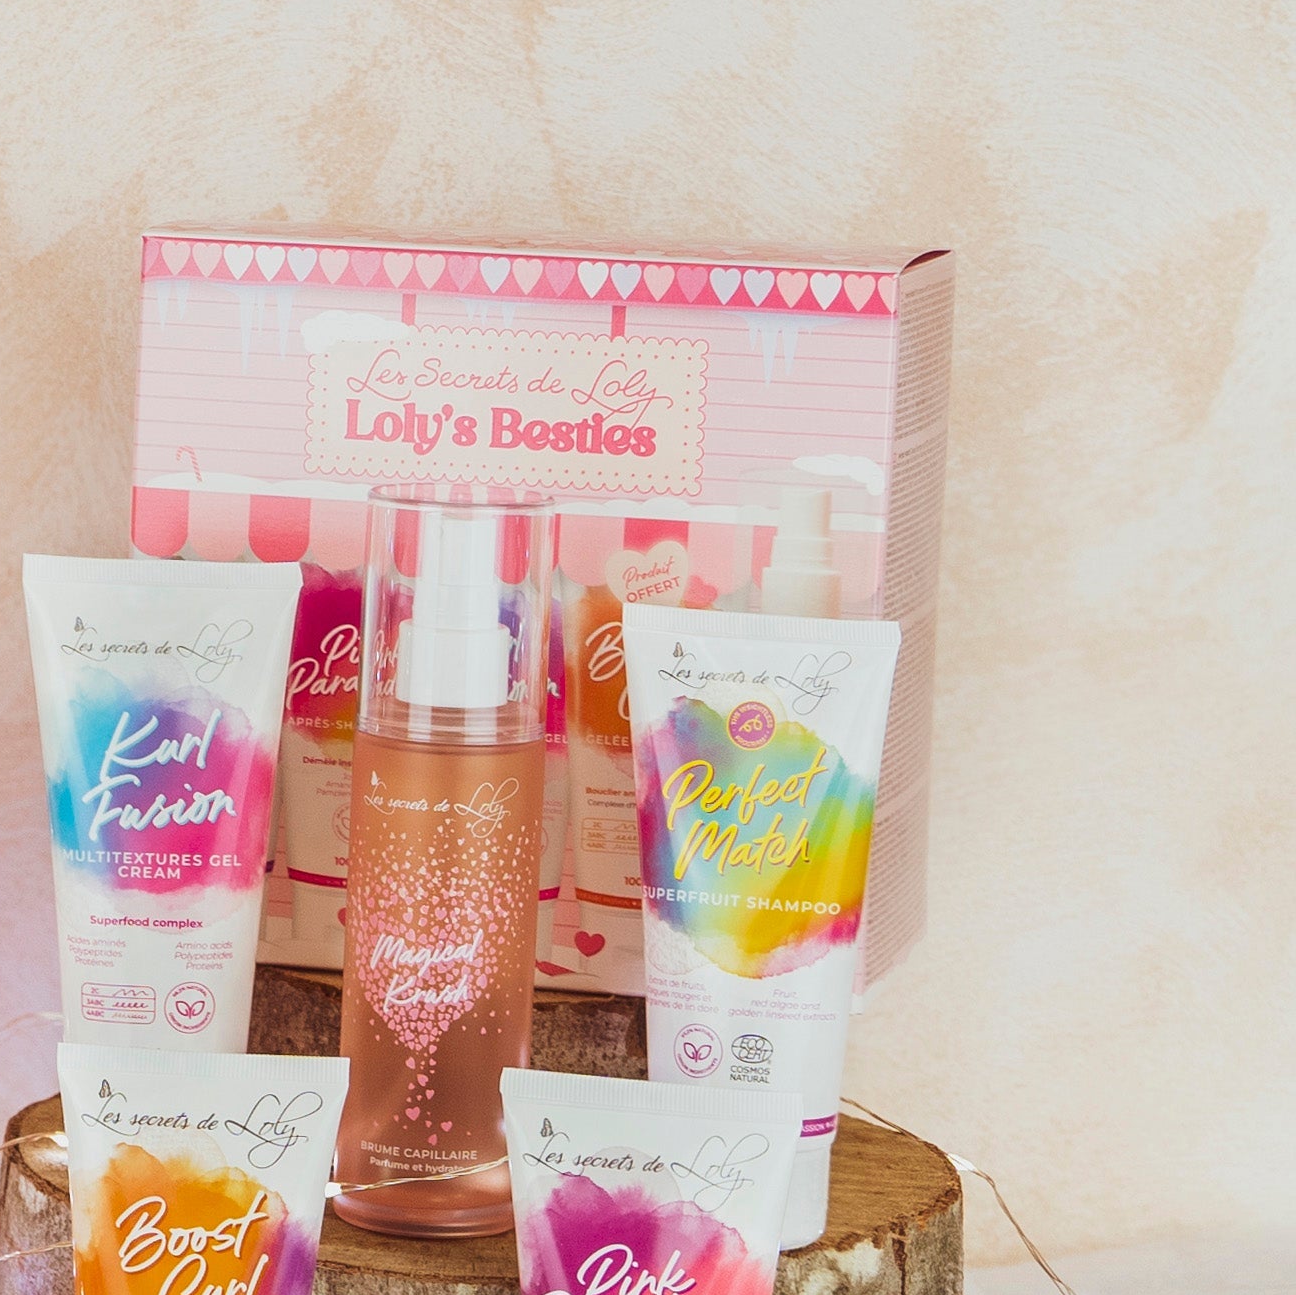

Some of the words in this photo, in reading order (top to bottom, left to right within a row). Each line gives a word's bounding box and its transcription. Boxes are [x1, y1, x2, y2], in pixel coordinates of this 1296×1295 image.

[347, 349, 411, 401] Les
[414, 358, 518, 393] Secrets
[527, 366, 565, 393] de
[571, 359, 674, 432] Loly
[344, 398, 478, 455] Loly's
[489, 407, 657, 457] Besties
[623, 556, 674, 589] Produit
[627, 576, 680, 603] OFFERT
[61, 626, 109, 662] Les
[100, 641, 147, 654] secrets
[155, 641, 172, 655] de
[176, 619, 253, 683] Loly
[659, 653, 708, 689] Les
[699, 670, 746, 684] secrets
[752, 671, 769, 685] de
[775, 651, 852, 715] Loly
[100, 708, 223, 782] Kurl
[587, 735, 629, 746] GELÉE
[82, 774, 237, 841] Fusion
[364, 781, 396, 815] Les
[388, 798, 429, 811] secrets
[434, 799, 450, 813] de
[454, 778, 519, 838] Loly
[662, 746, 828, 831] Perfect
[61, 848, 202, 866] MULTITEXTURES
[209, 854, 242, 866] GEL
[674, 813, 811, 881] Match
[118, 866, 180, 879] CREAM
[90, 915, 149, 927] Superfood
[153, 919, 203, 929] complex
[643, 885, 740, 906] SUPERFRUIT
[747, 897, 840, 915] SHAMPOO
[370, 929, 483, 978] Magical
[383, 974, 468, 1013] Krush
[730, 1066, 770, 1075] COSMOS
[730, 1074, 770, 1084] NATURAL
[81, 1092, 141, 1136] Les
[130, 1112, 190, 1128] secrets
[196, 1113, 218, 1130] de
[225, 1091, 323, 1169] Loly
[361, 1140, 400, 1156] BRUME
[404, 1148, 478, 1160] CAPILLAIRE
[370, 1156, 409, 1170] Parfume
[523, 1132, 584, 1176] Les
[573, 1154, 635, 1170] secrets
[642, 1156, 664, 1173] de
[670, 1134, 769, 1212] Loly
[115, 1190, 269, 1272] Boost
